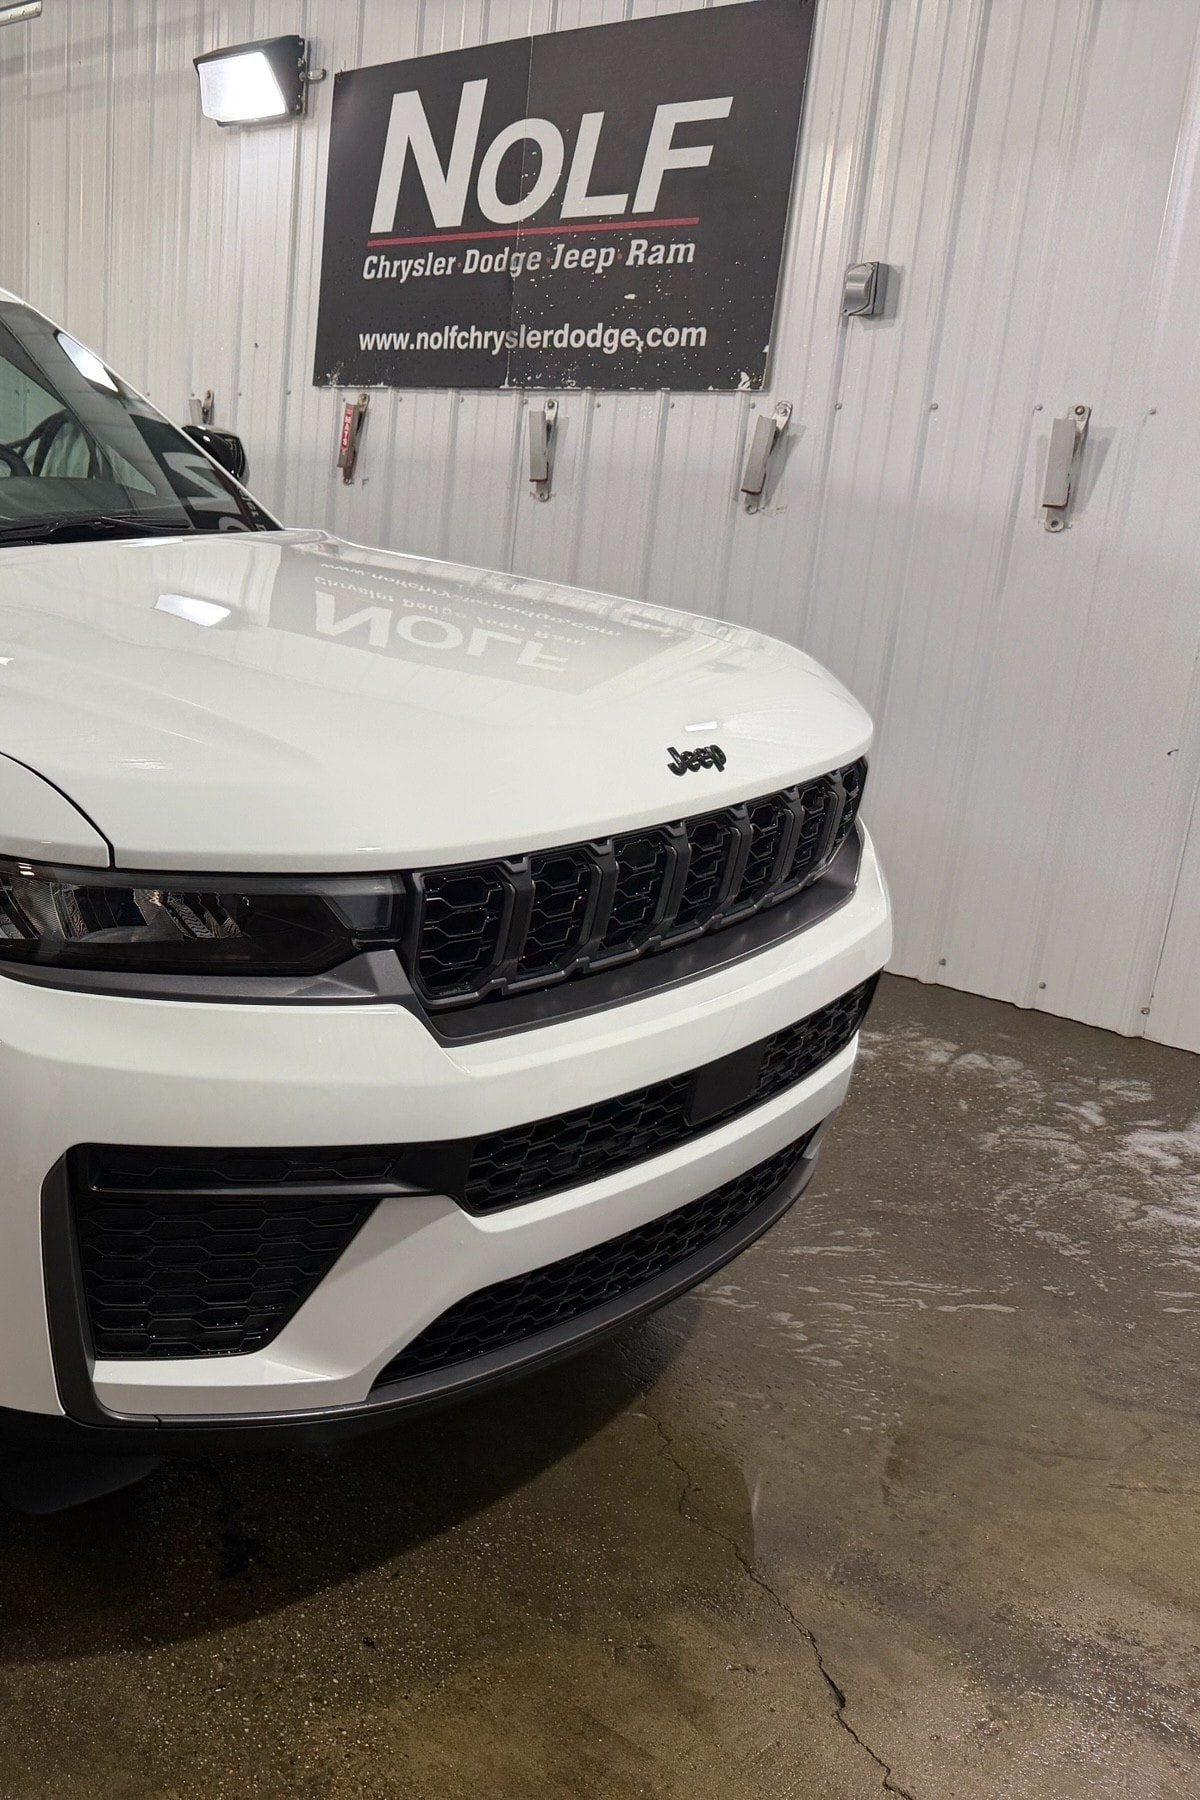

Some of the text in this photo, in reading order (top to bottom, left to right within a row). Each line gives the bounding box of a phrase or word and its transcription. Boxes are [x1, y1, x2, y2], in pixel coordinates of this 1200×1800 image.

[370, 78, 734, 233] NOLF
[363, 238, 696, 283] Chrysler Dodge Jeep Ram
[359, 322, 707, 354] www.nolfchryslerdodge.com
[666, 745, 727, 777] Jeep
